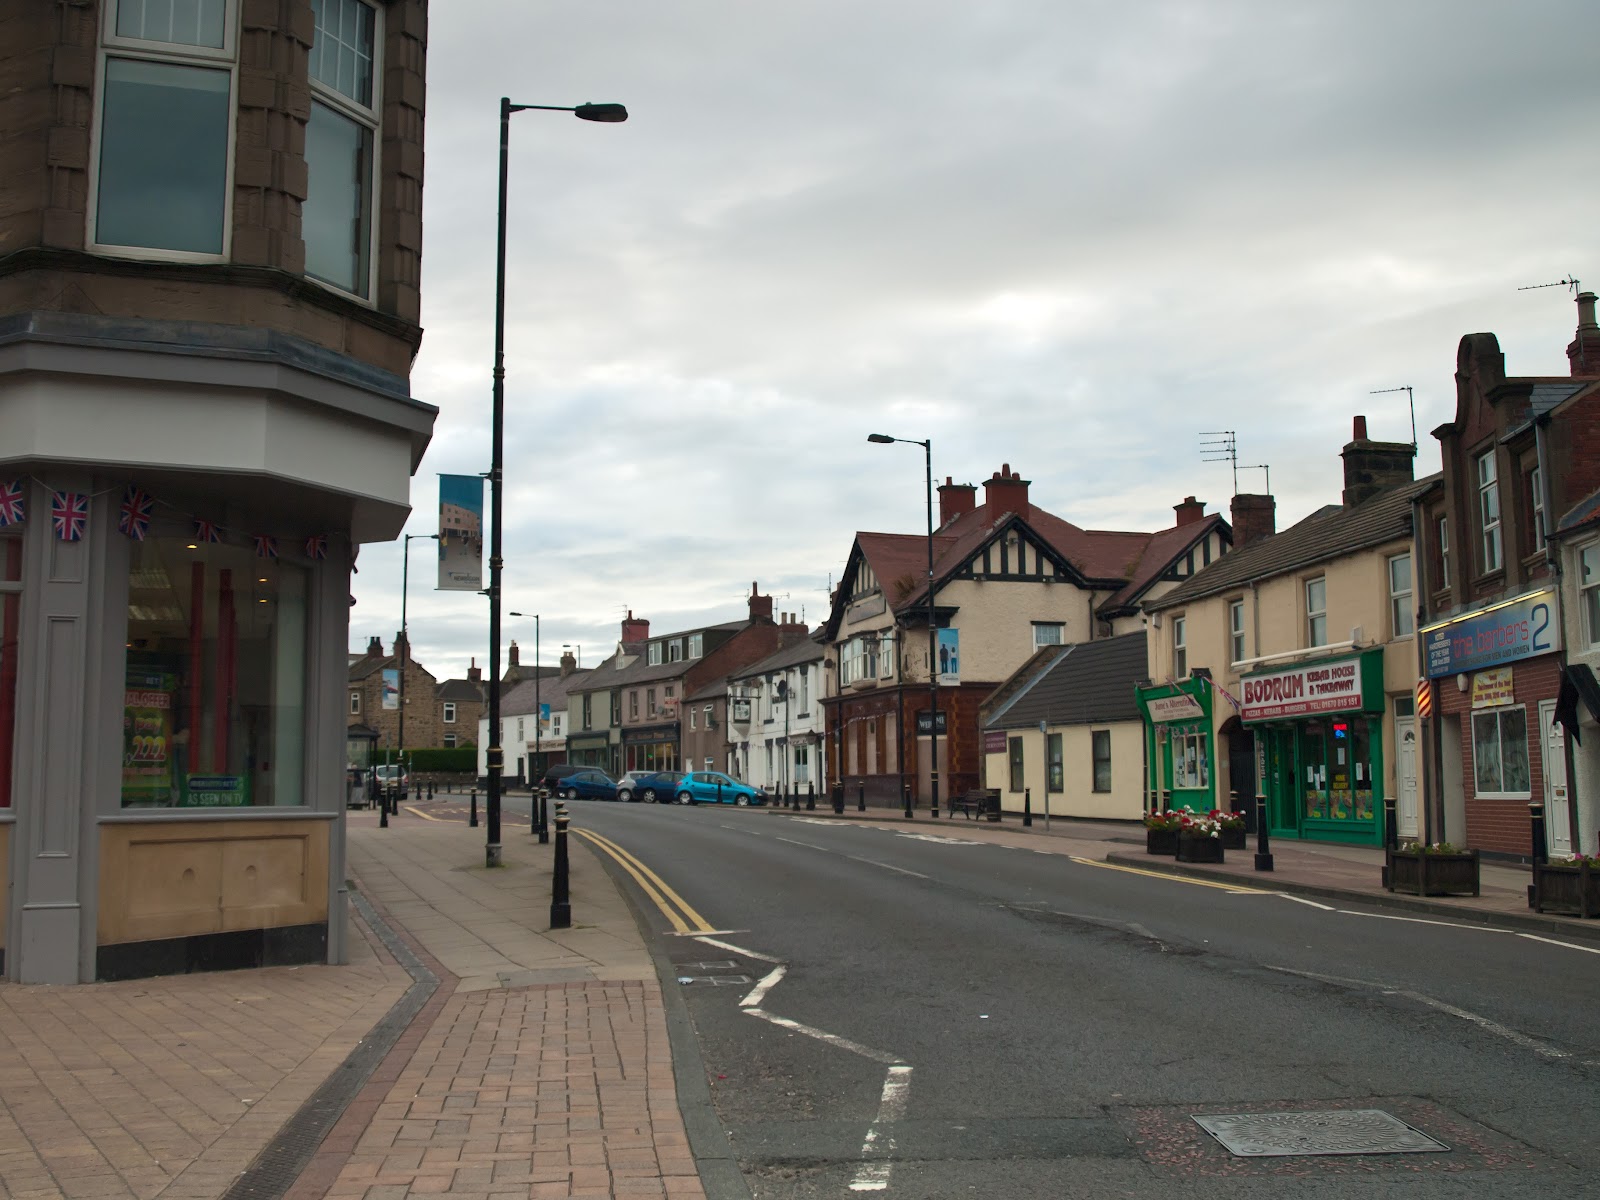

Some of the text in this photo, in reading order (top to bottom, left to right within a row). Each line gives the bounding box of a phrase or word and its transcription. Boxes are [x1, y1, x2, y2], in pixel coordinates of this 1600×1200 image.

[1453, 603, 1551, 659] the barbers 2
[1502, 647, 1511, 658] AND
[1512, 643, 1530, 656] WOMEN
[1306, 664, 1355, 683] KEBAB HOUSE
[1244, 673, 1304, 705] BODRUM
[1315, 678, 1355, 695] TAKEAWAY
[1284, 703, 1307, 713] BURGERS
[187, 793, 198, 805] AS
[199, 793, 220, 805] SEEN
[221, 793, 232, 805] ON
